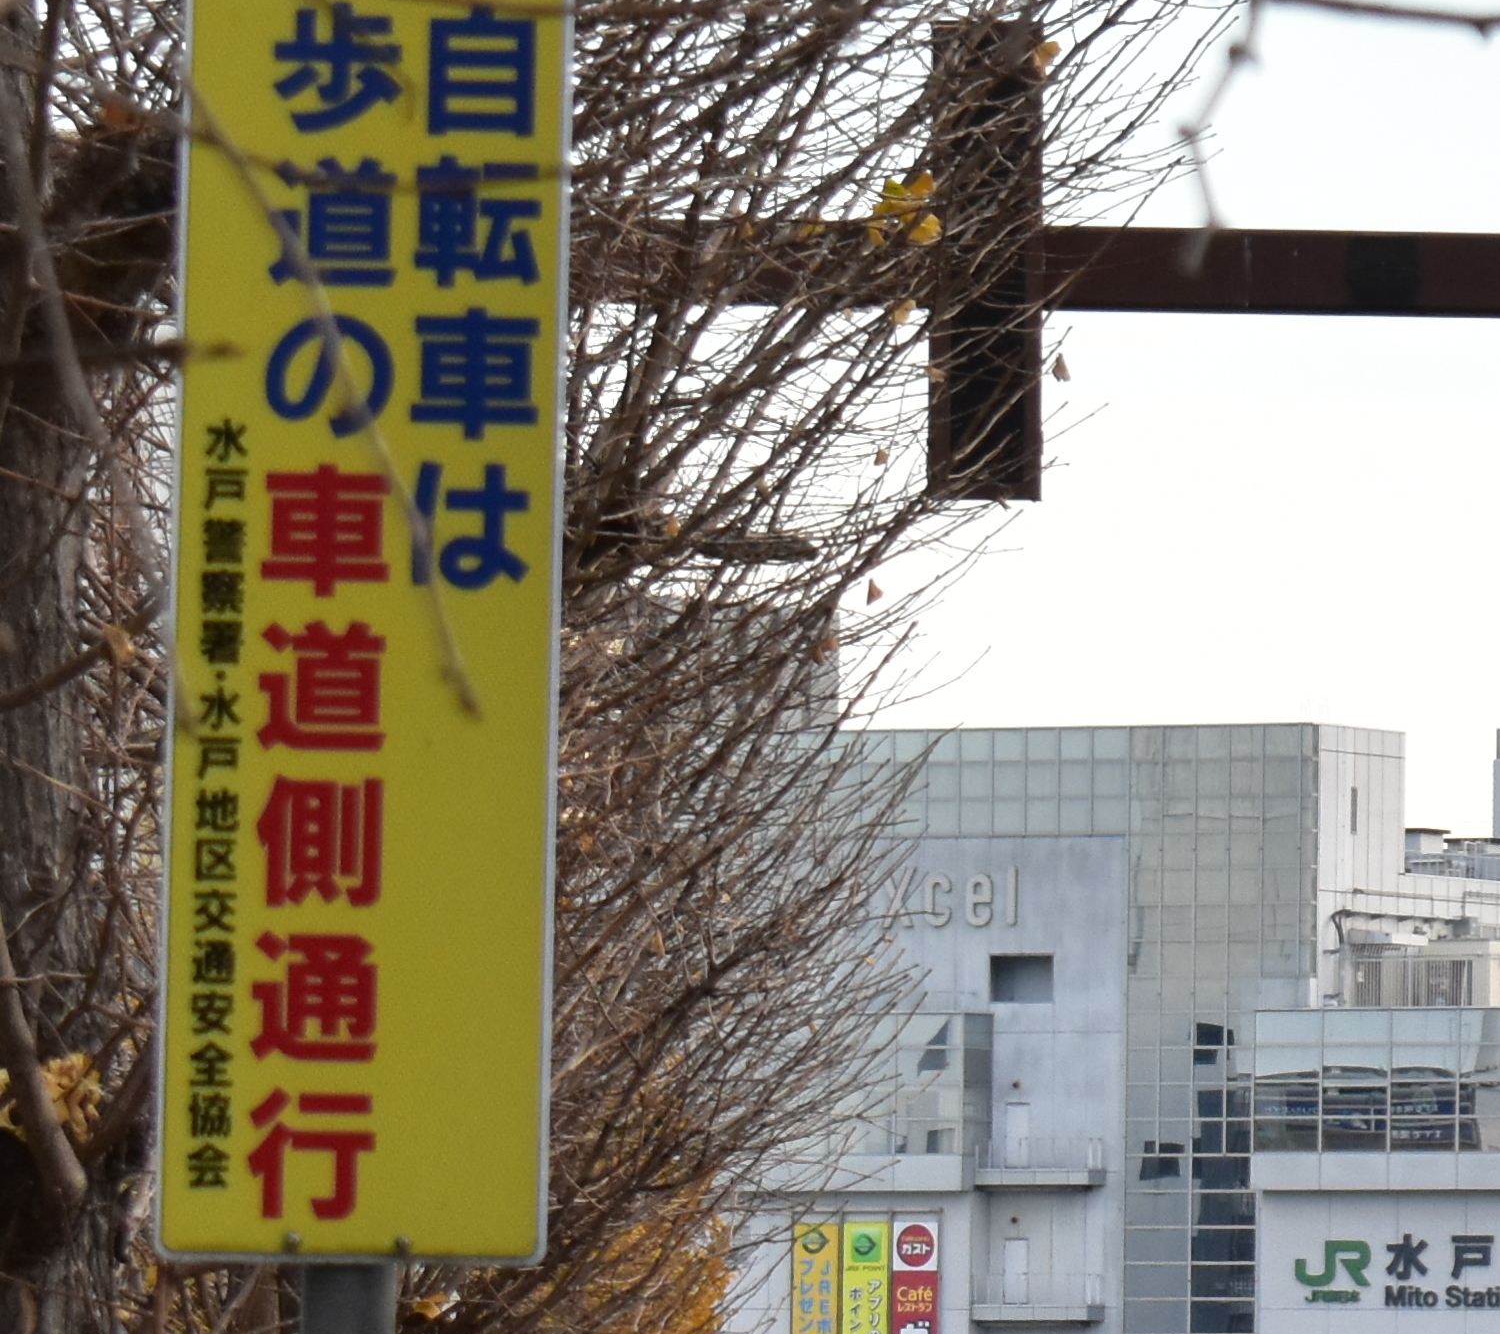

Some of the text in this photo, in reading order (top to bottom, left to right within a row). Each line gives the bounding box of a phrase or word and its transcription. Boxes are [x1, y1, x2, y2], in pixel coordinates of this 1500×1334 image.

[407, 4, 542, 591] 自転車は
[901, 1243, 932, 1255] ガスト
[1294, 1239, 1372, 1287] JR
[897, 1285, 933, 1302] Café
[1385, 1284, 1438, 1308] Mito
[897, 1303, 933, 1313] レストラン
